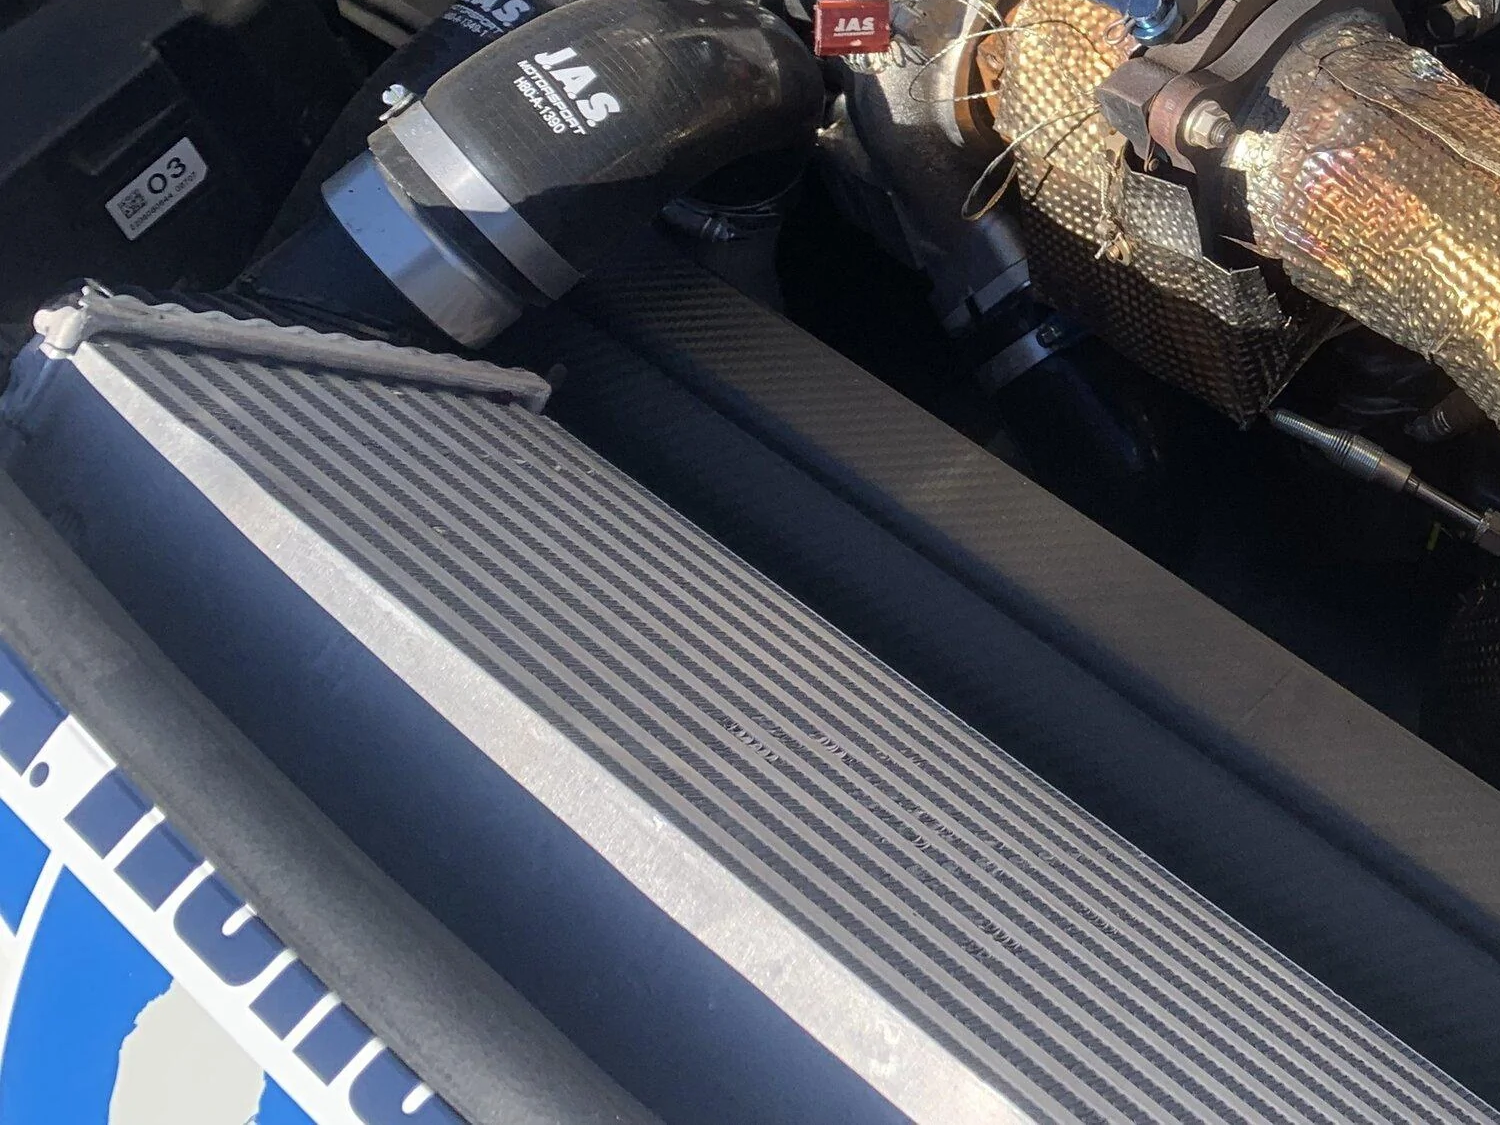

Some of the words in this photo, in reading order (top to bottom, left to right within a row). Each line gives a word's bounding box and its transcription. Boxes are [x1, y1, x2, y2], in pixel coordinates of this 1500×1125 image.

[833, 16, 876, 33] JAS
[513, 76, 566, 134] H80-A-1390
[517, 59, 587, 135] MOTORSPORT
